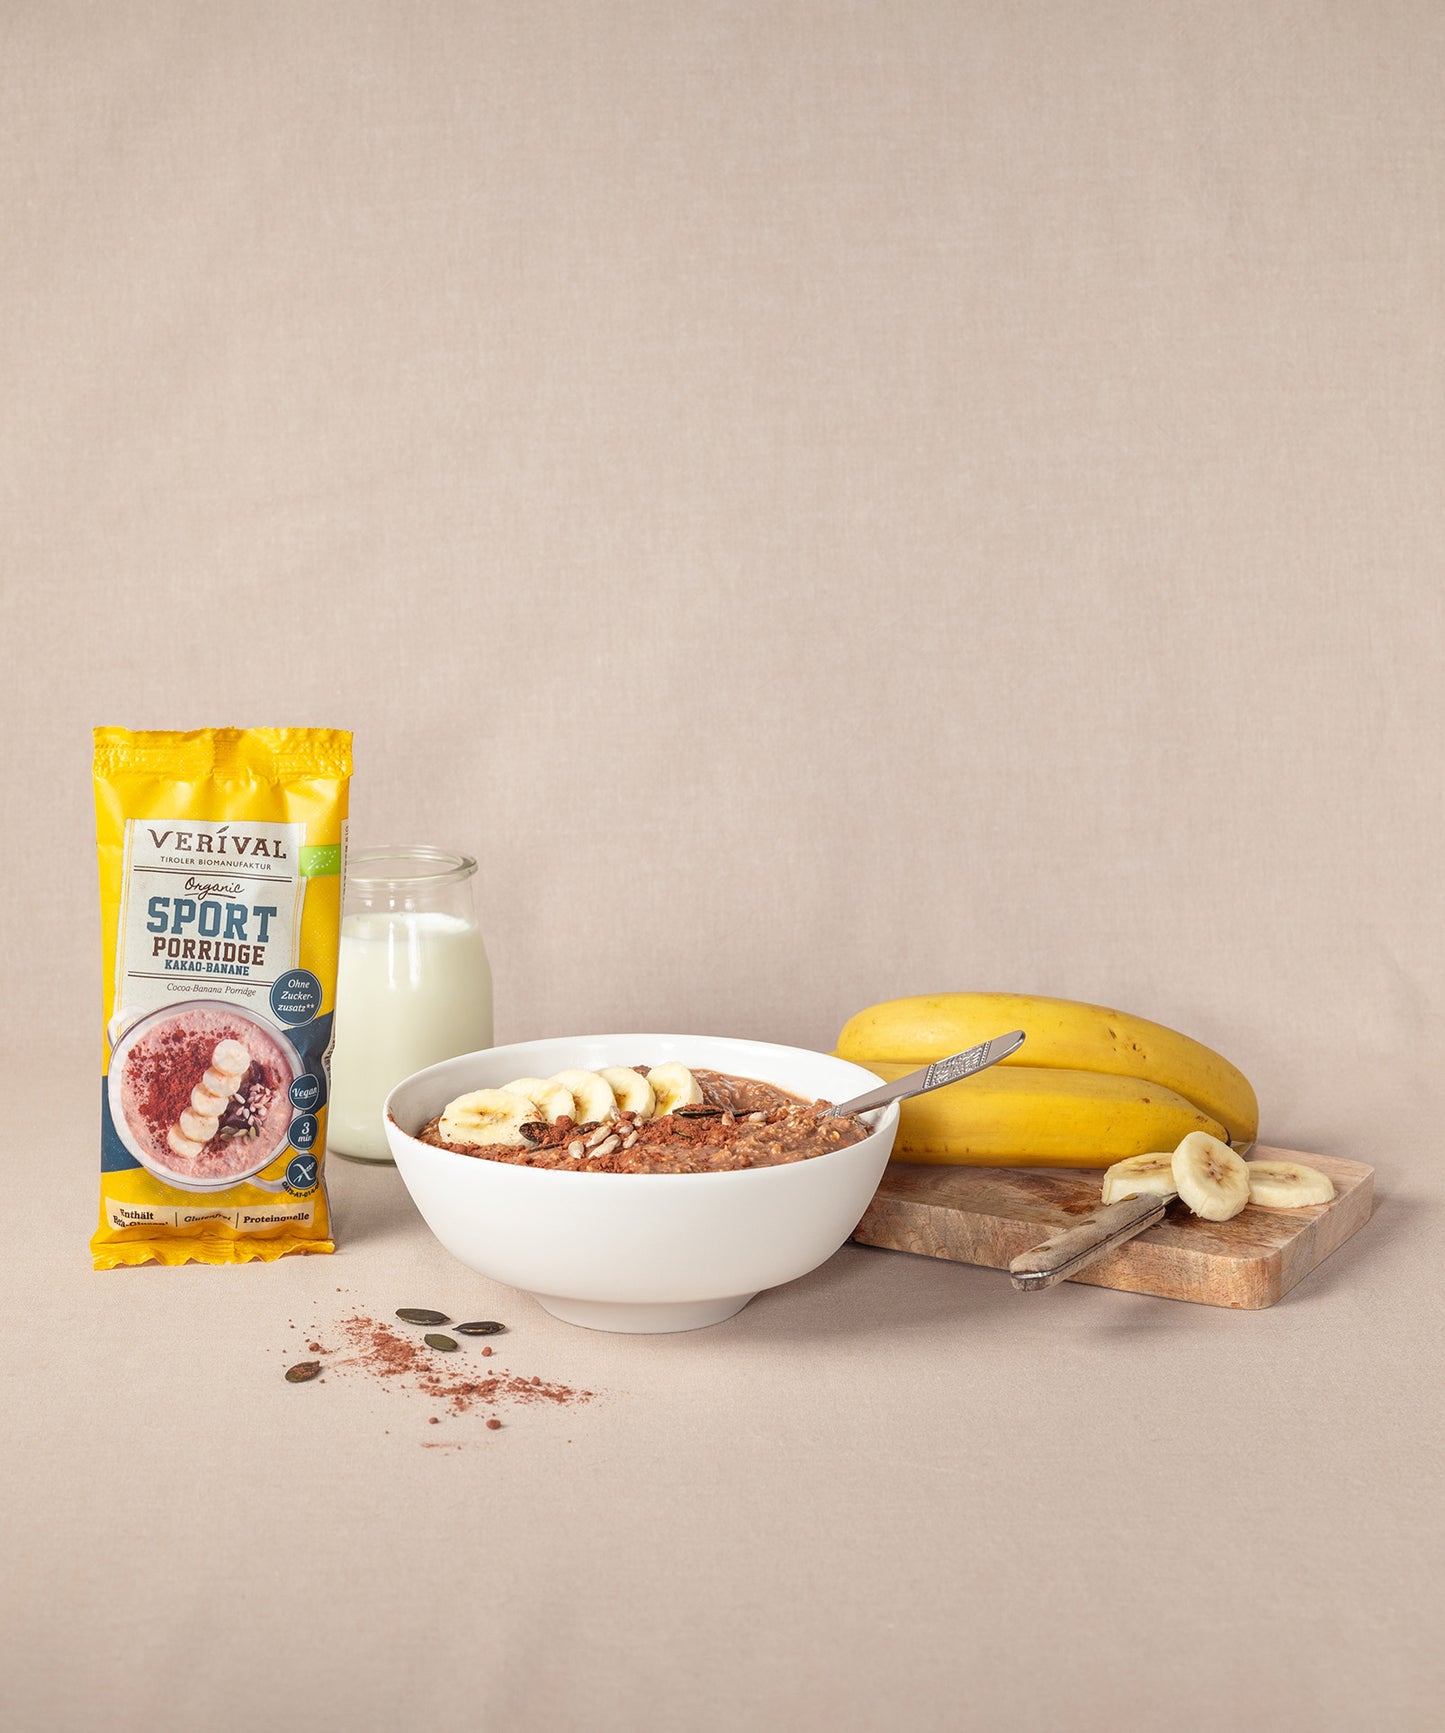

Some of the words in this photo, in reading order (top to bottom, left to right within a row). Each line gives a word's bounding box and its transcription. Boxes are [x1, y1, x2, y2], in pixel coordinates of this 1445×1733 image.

[147, 826, 287, 859] VERÍVAL
[160, 856, 195, 865] TIROLER
[198, 859, 271, 870] BIOMANUFAKTUR
[184, 876, 245, 900] Organic
[146, 896, 277, 943] SPORT
[152, 936, 266, 966] PORRIDGE
[164, 959, 250, 976] KAKAO-BANANE
[166, 983, 222, 994] Cocoa-Banana
[224, 986, 256, 997] Porridge
[288, 979, 310, 989] Ohne
[280, 990, 313, 1001] Zucker-
[292, 1087, 318, 1099] Vegan
[302, 1122, 310, 1135] 3
[297, 1134, 312, 1143] min
[120, 1208, 154, 1220] Enthält
